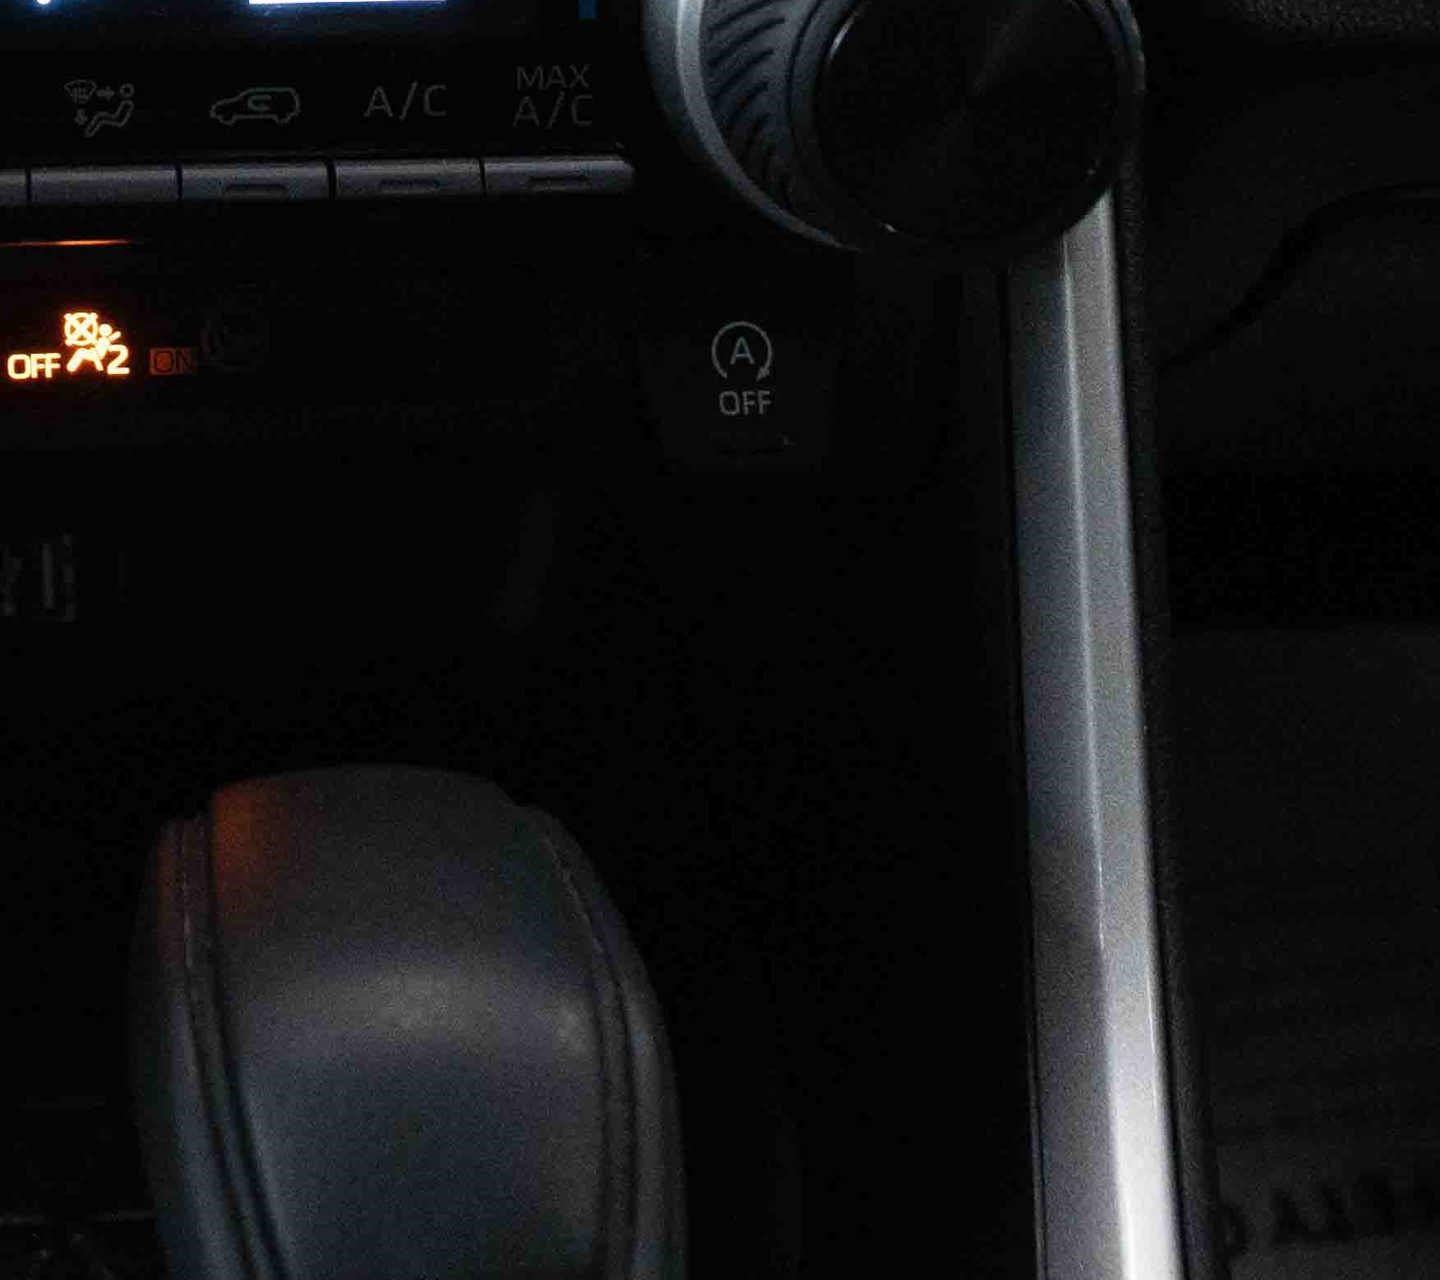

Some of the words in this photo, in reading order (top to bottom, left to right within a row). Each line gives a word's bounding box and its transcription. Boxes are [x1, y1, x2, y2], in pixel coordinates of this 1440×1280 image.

[515, 63, 592, 92] MAX
[362, 80, 447, 122] A/C
[511, 90, 592, 130] A/C
[6, 351, 62, 380] OFF
[719, 390, 772, 416] OFF
